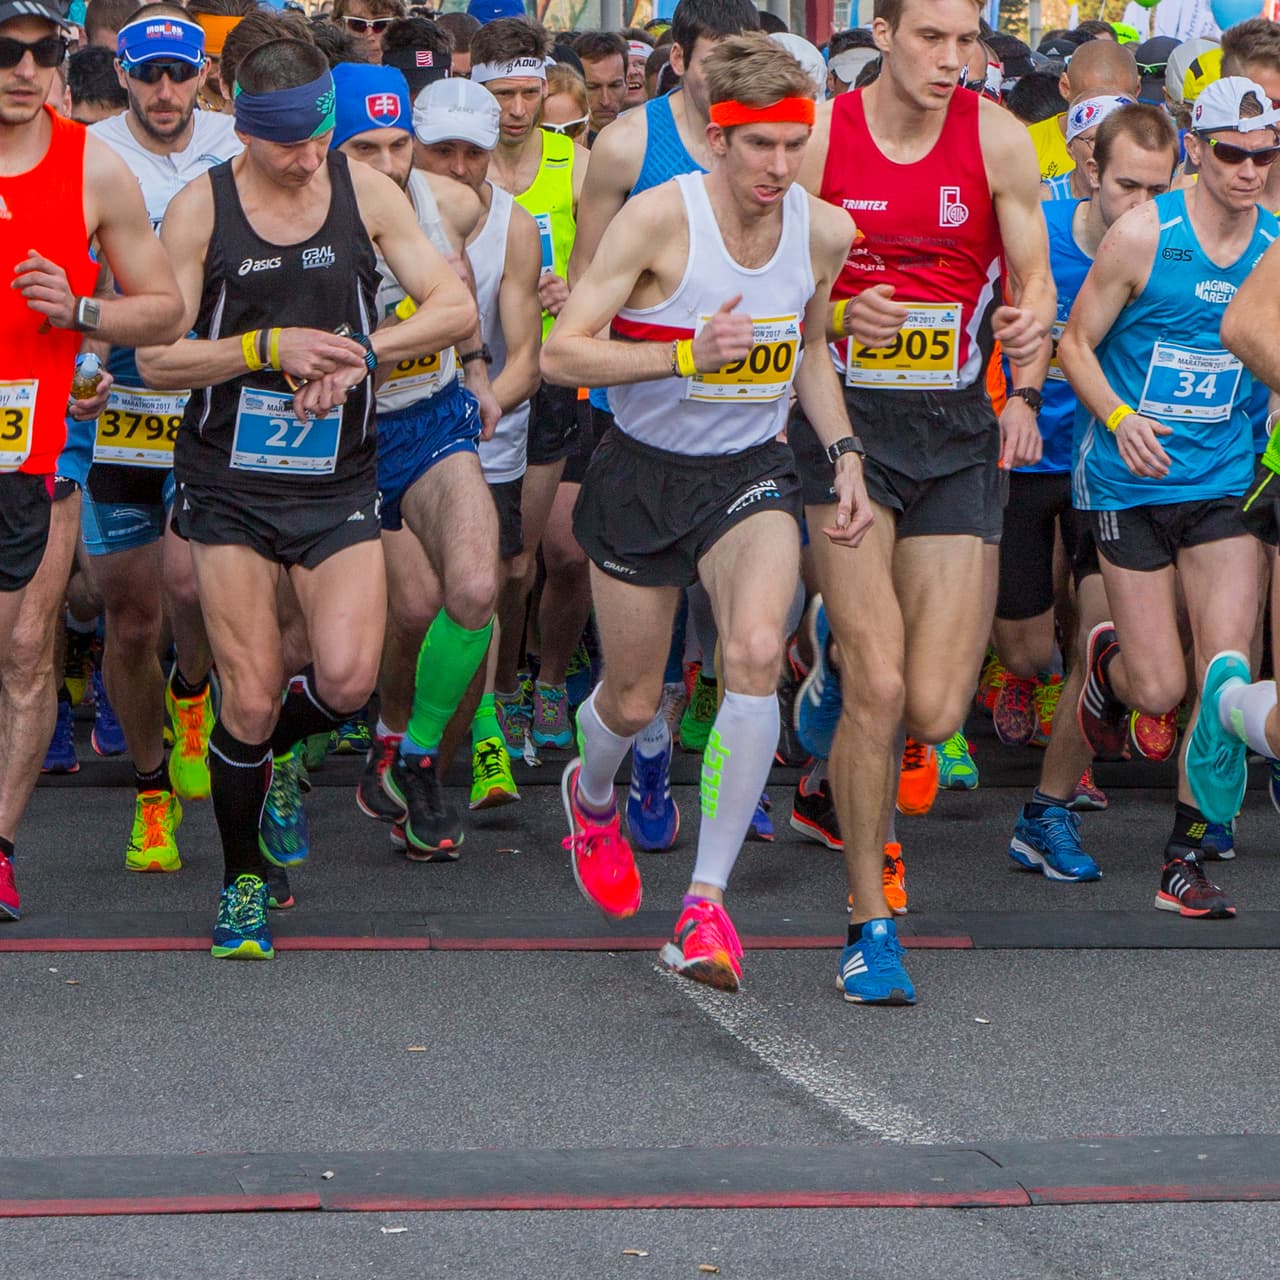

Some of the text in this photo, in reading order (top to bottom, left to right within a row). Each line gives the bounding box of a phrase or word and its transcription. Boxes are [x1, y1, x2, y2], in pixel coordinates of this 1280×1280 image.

[842, 199, 888, 211] TRIMTEX
[252, 257, 282, 272] asics
[1178, 358, 1213, 368] MARATHON
[1173, 371, 1218, 400] 34
[122, 400, 171, 410] MARATHON 2017
[101, 409, 181, 441] 3798
[265, 419, 314, 448] 27
